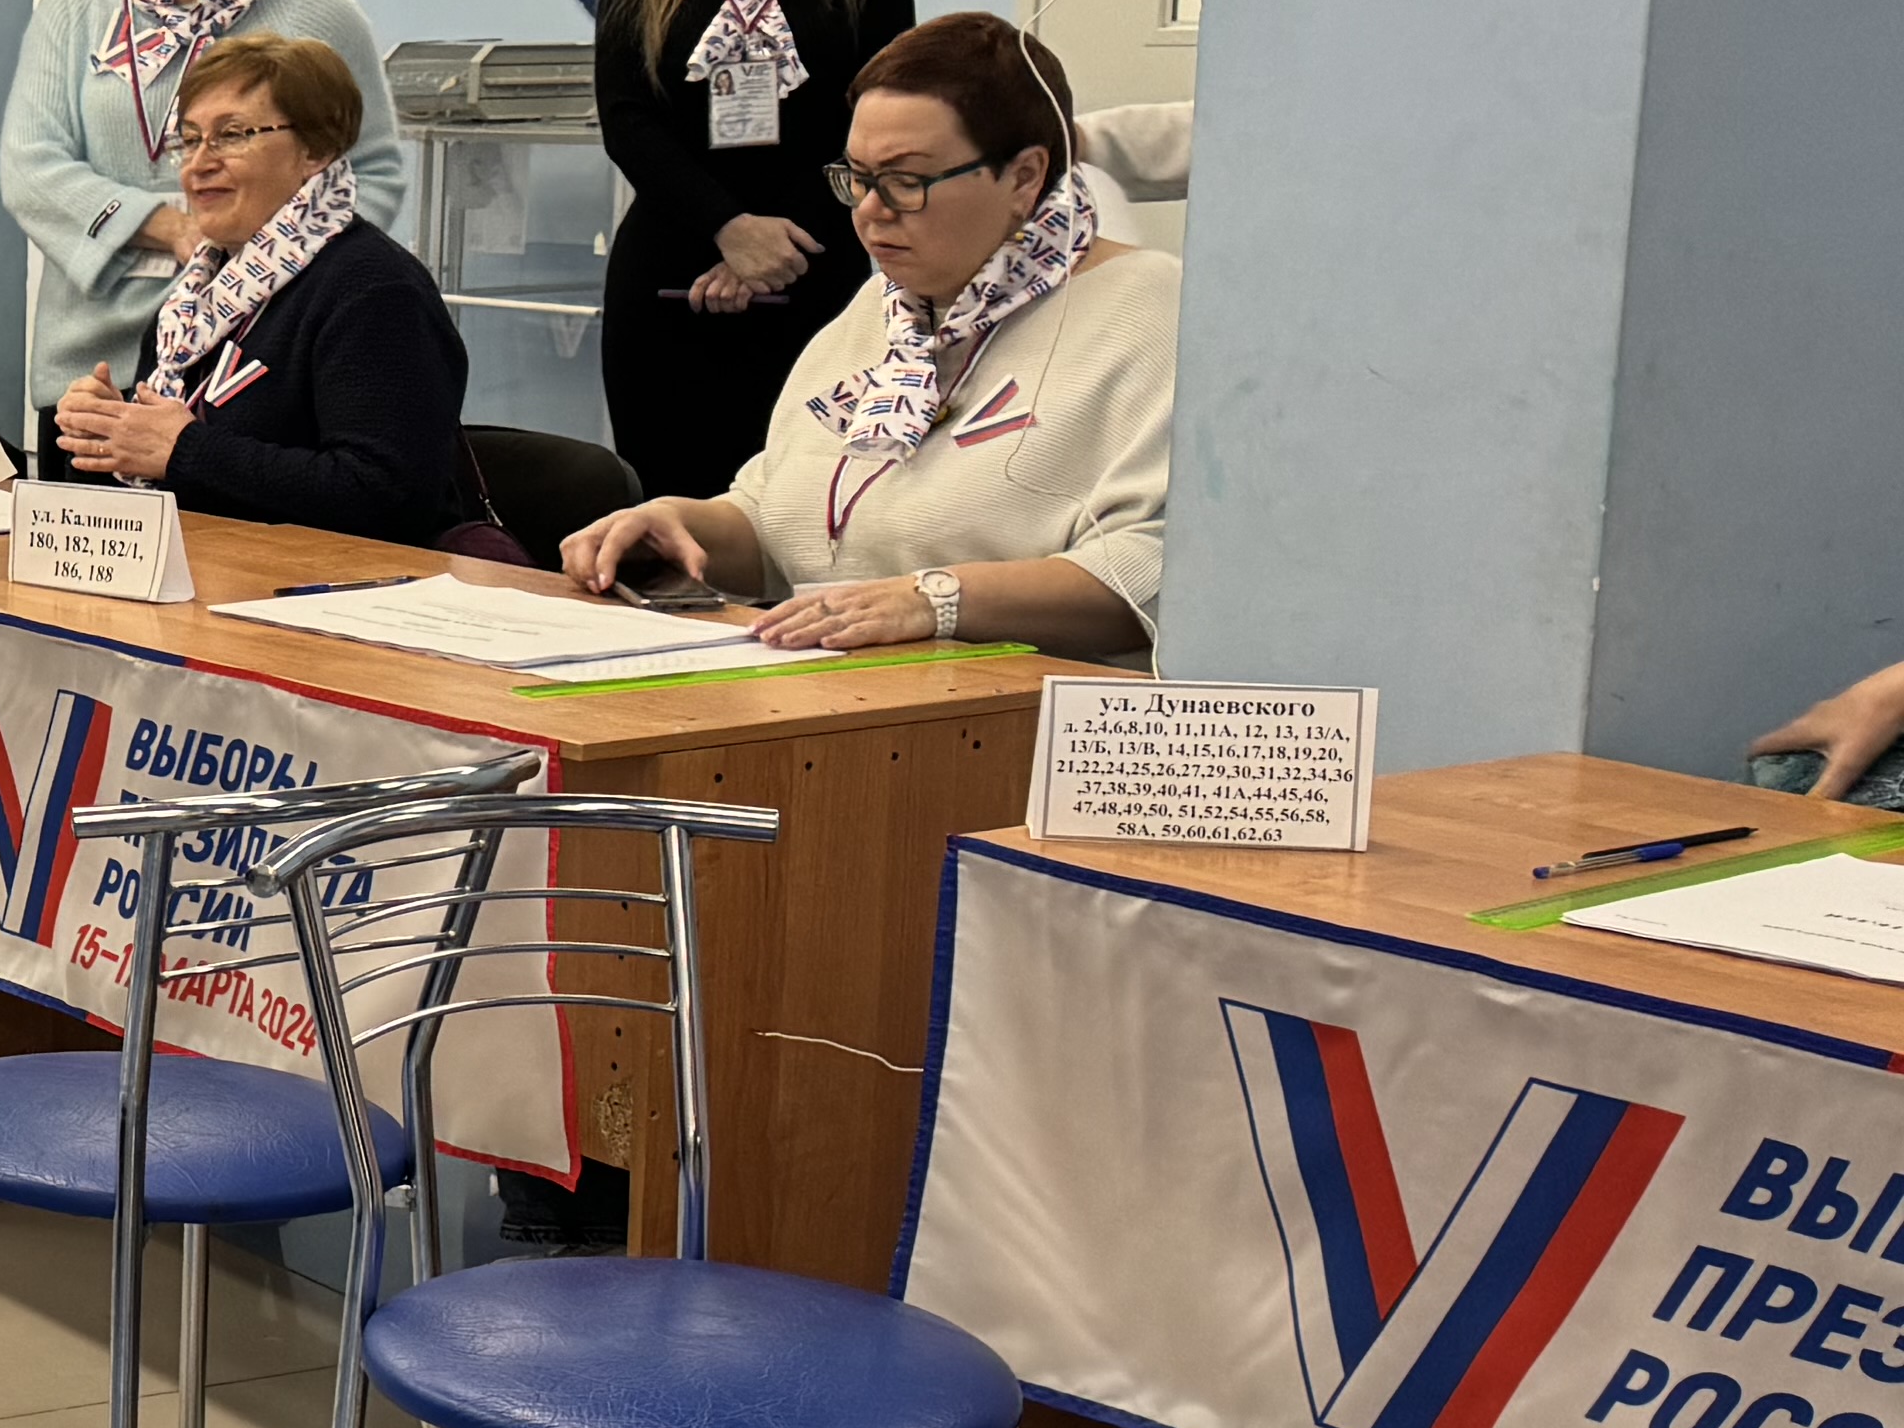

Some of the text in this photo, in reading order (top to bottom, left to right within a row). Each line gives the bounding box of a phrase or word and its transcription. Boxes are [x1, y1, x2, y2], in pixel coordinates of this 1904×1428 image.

[31, 508, 143, 532] ул. Калинина
[29, 531, 144, 563] 180, 182, 182/1,
[54, 560, 114, 583] 186, 188
[1099, 693, 1316, 718] ул. Дунаевского
[1245, 724, 1268, 740] 12,
[1275, 725, 1299, 741] 13,
[1070, 739, 1111, 757] 13/Б,
[1118, 741, 1161, 758] 13/В,
[1116, 822, 1156, 839] 58А,
[93, 858, 254, 953] РОСИИ
[258, 988, 317, 1057] 2024
[1719, 1137, 1904, 1265] ВЫ
